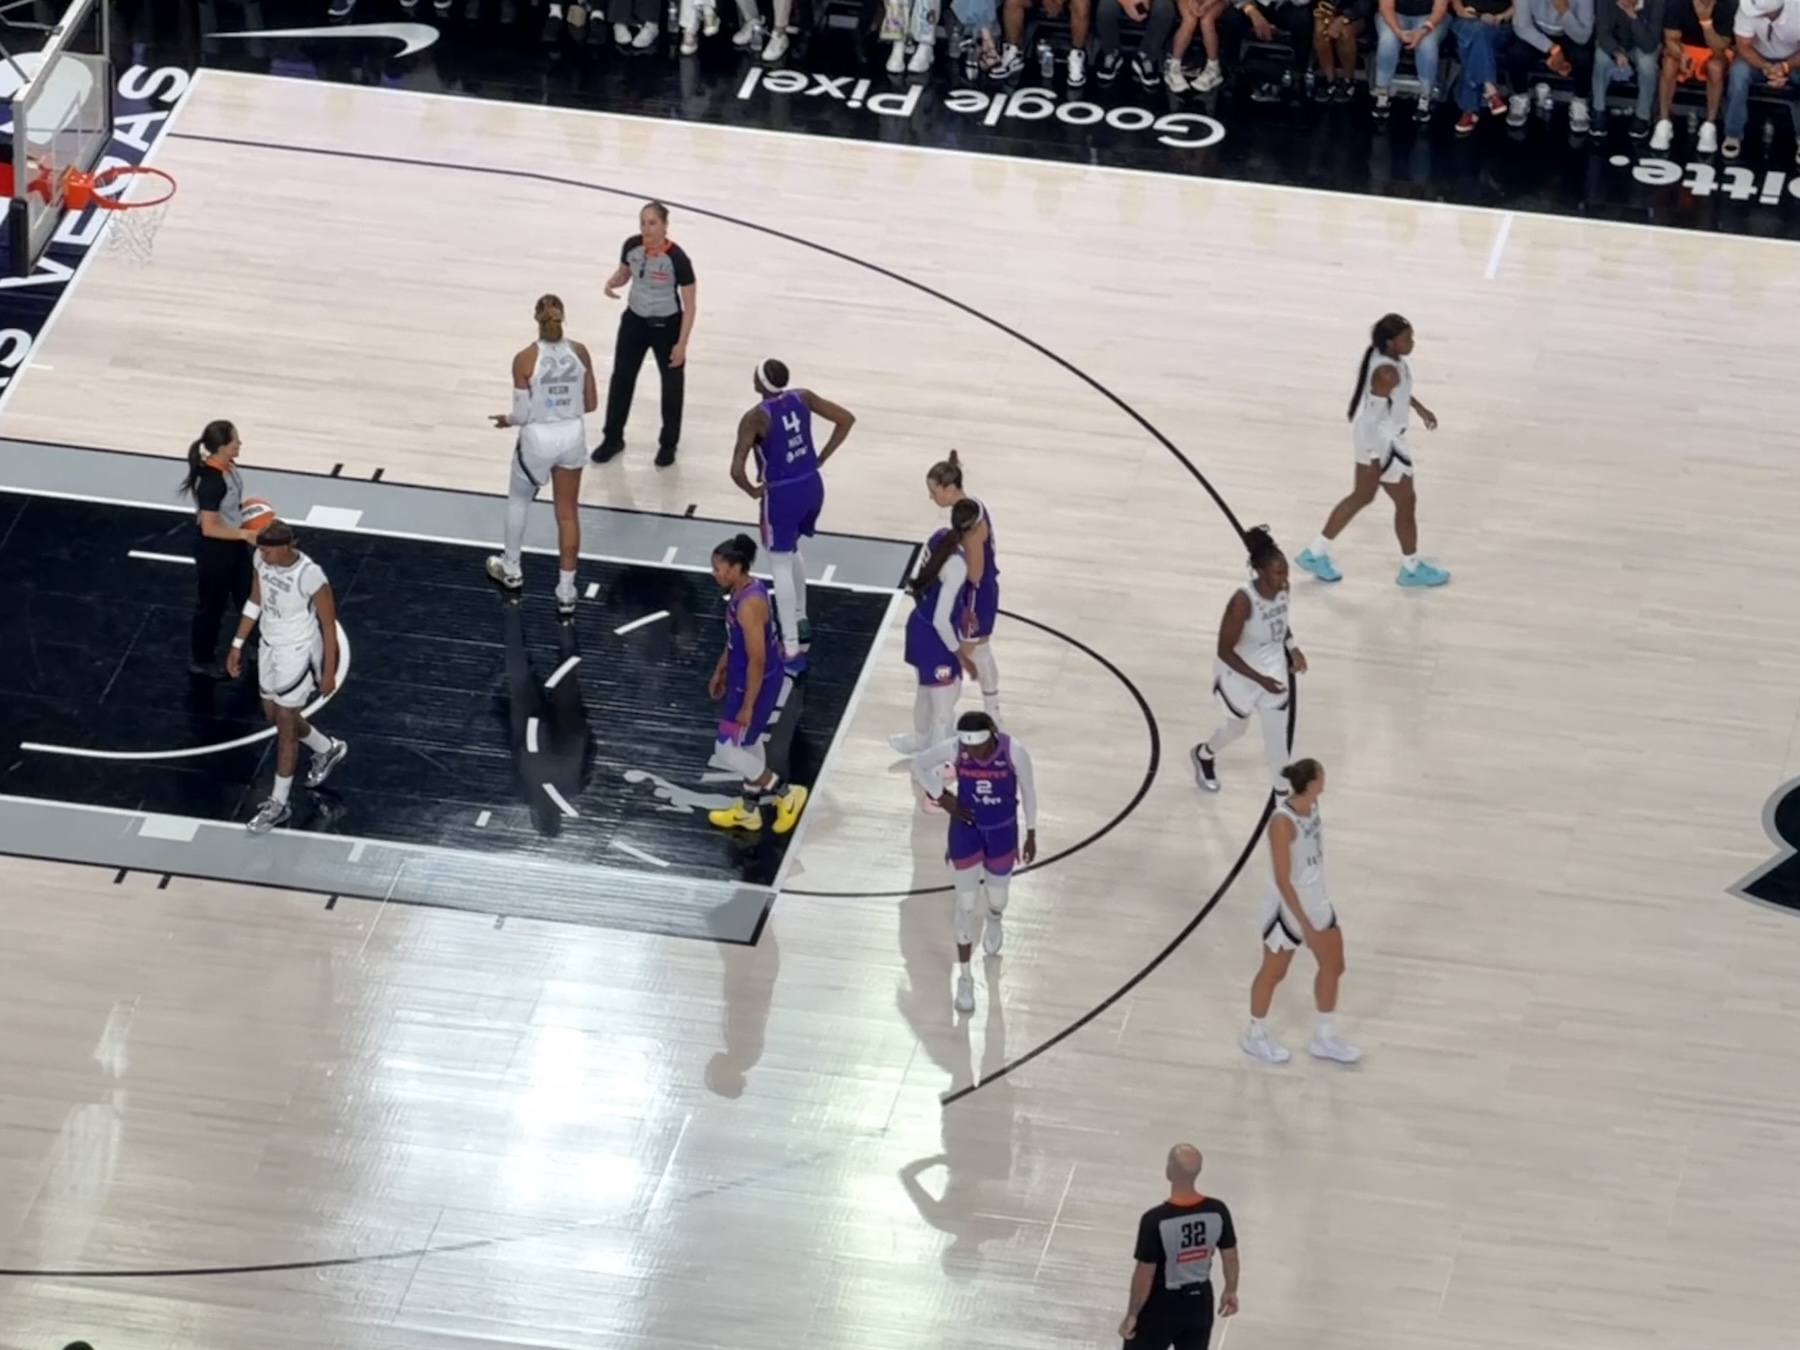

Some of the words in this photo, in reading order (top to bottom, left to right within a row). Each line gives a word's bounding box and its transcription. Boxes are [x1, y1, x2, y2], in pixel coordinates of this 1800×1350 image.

[737, 66, 923, 117] Pixel
[944, 87, 1226, 149] Google
[1608, 154, 1800, 205] itte.
[540, 356, 578, 385] 22
[781, 410, 800, 433] 4
[975, 779, 993, 795] 2
[1180, 1220, 1206, 1248] 32
